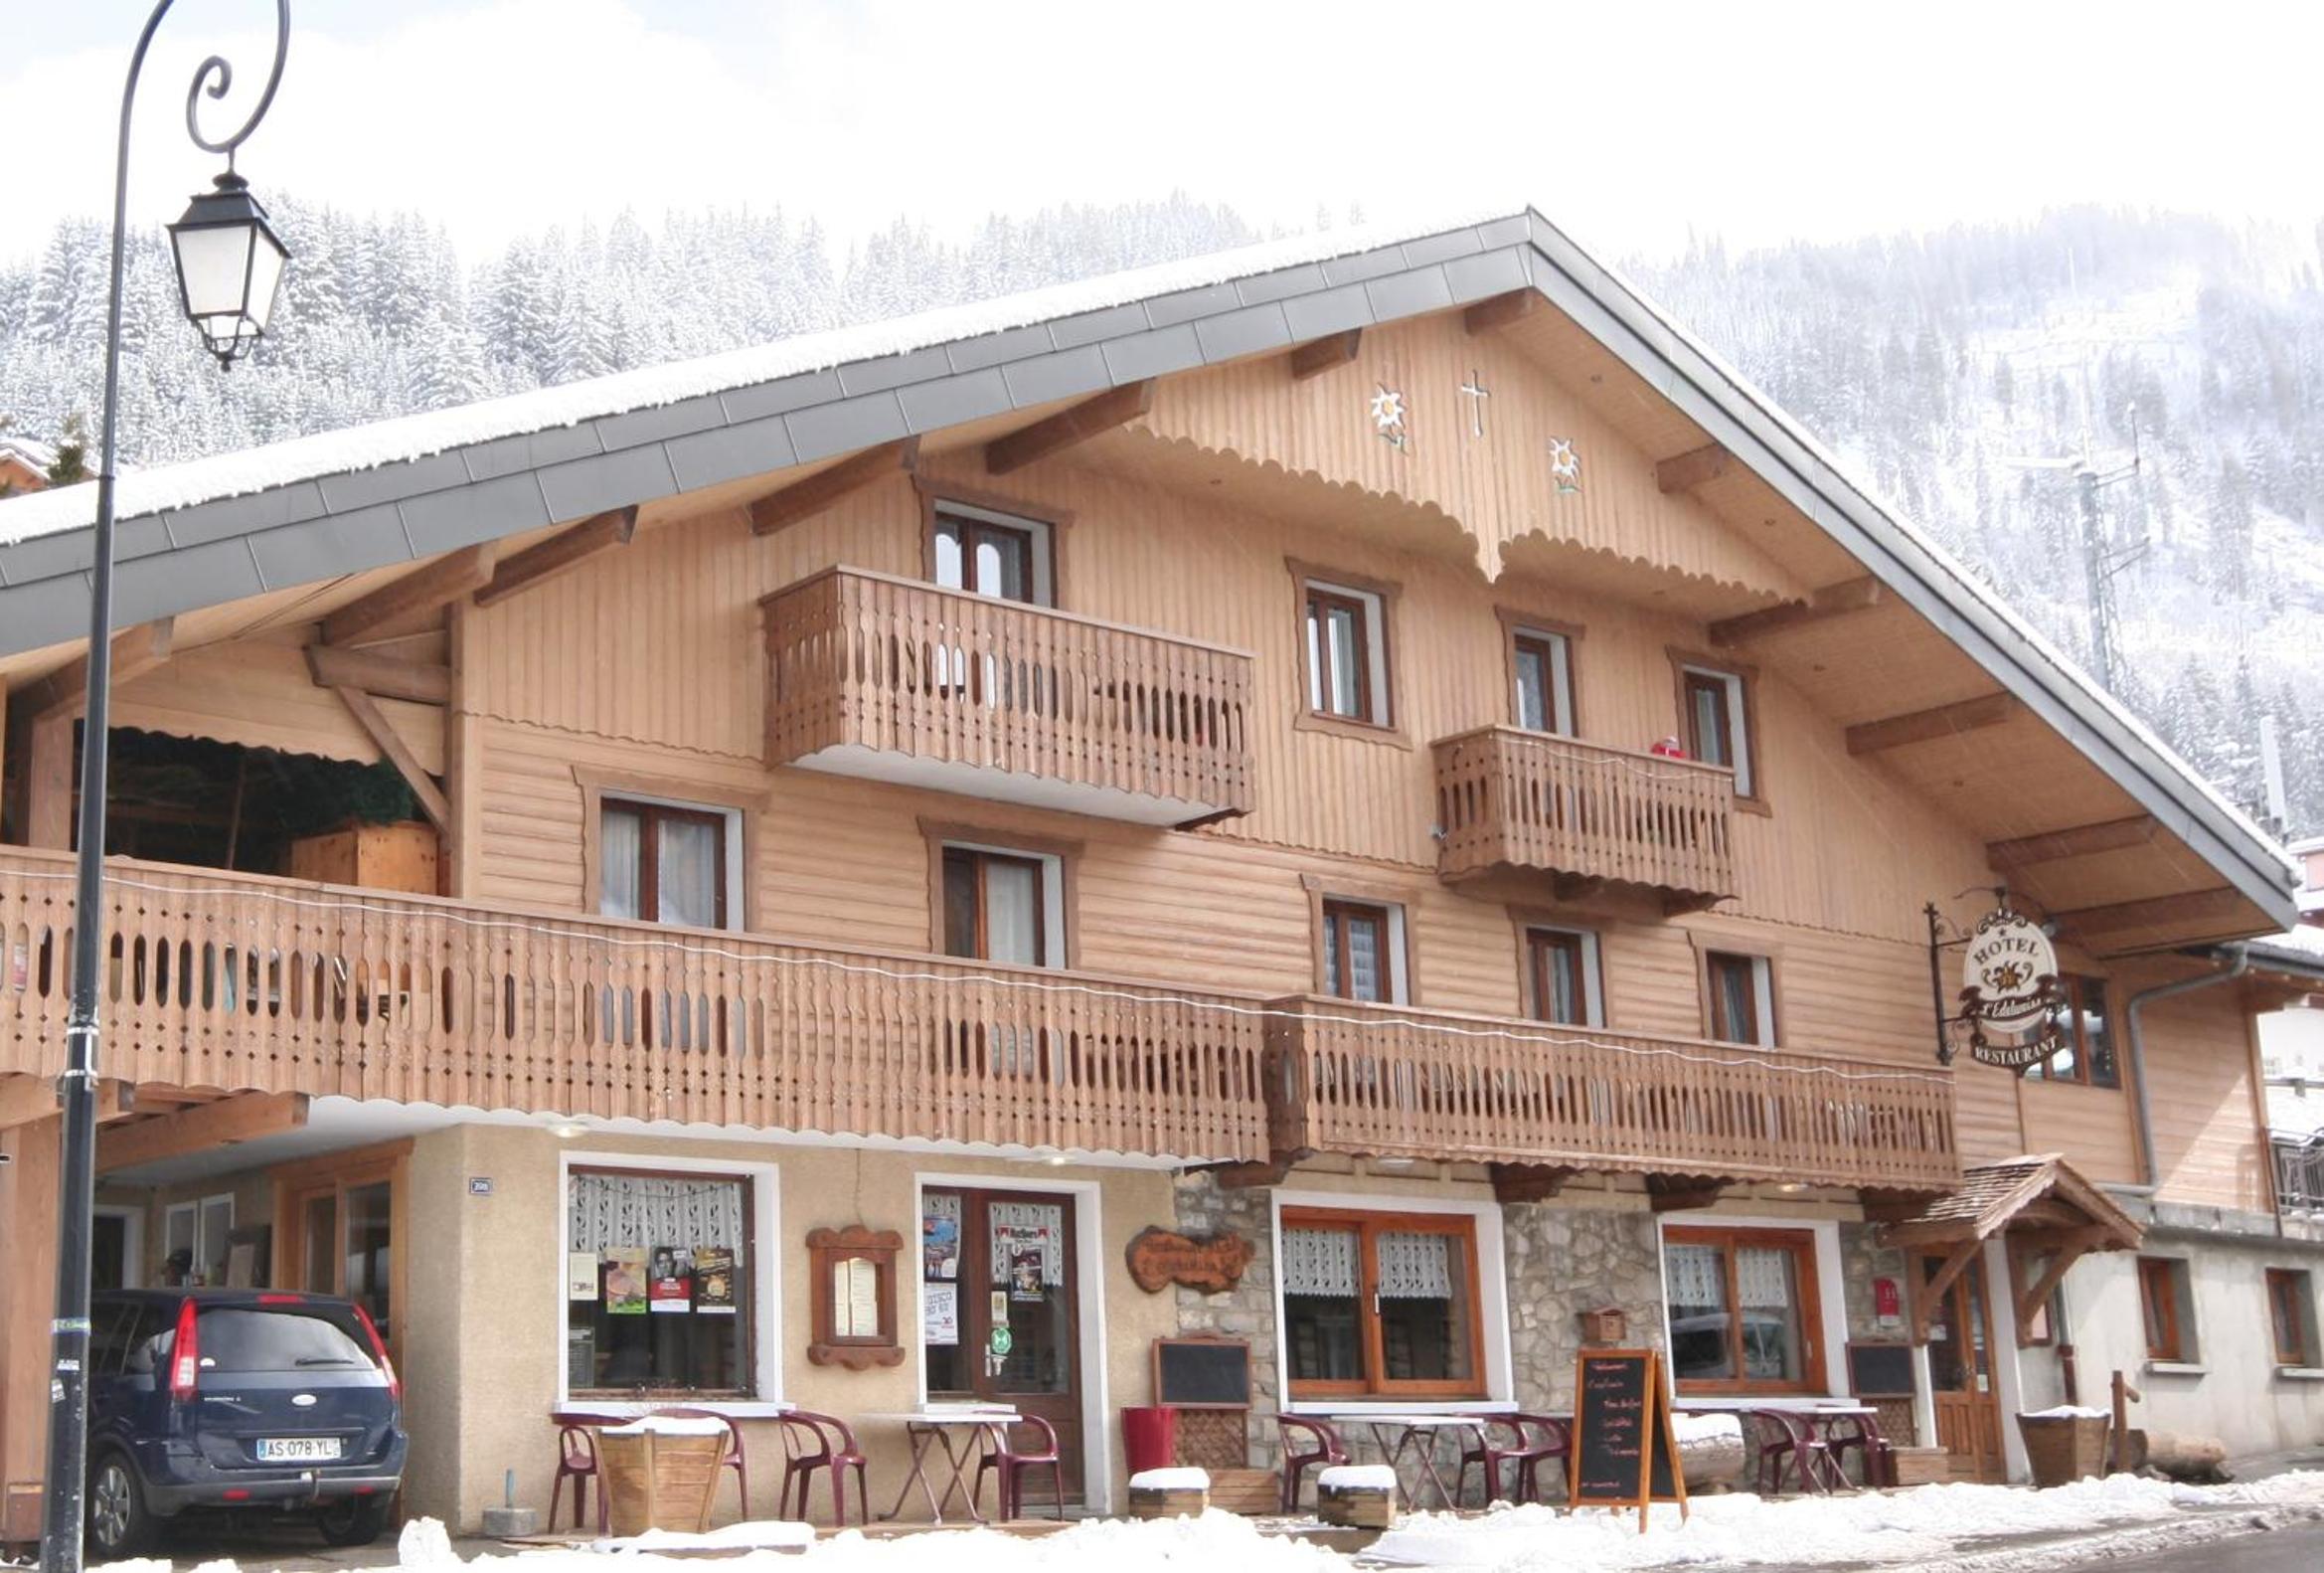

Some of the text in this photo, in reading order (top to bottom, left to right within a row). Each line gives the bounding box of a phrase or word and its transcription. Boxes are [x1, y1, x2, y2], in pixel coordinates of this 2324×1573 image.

[1973, 938, 2040, 965] HOTEL
[1974, 1035, 2057, 1065] RESTAURANT
[287, 1441, 312, 1457] 078
